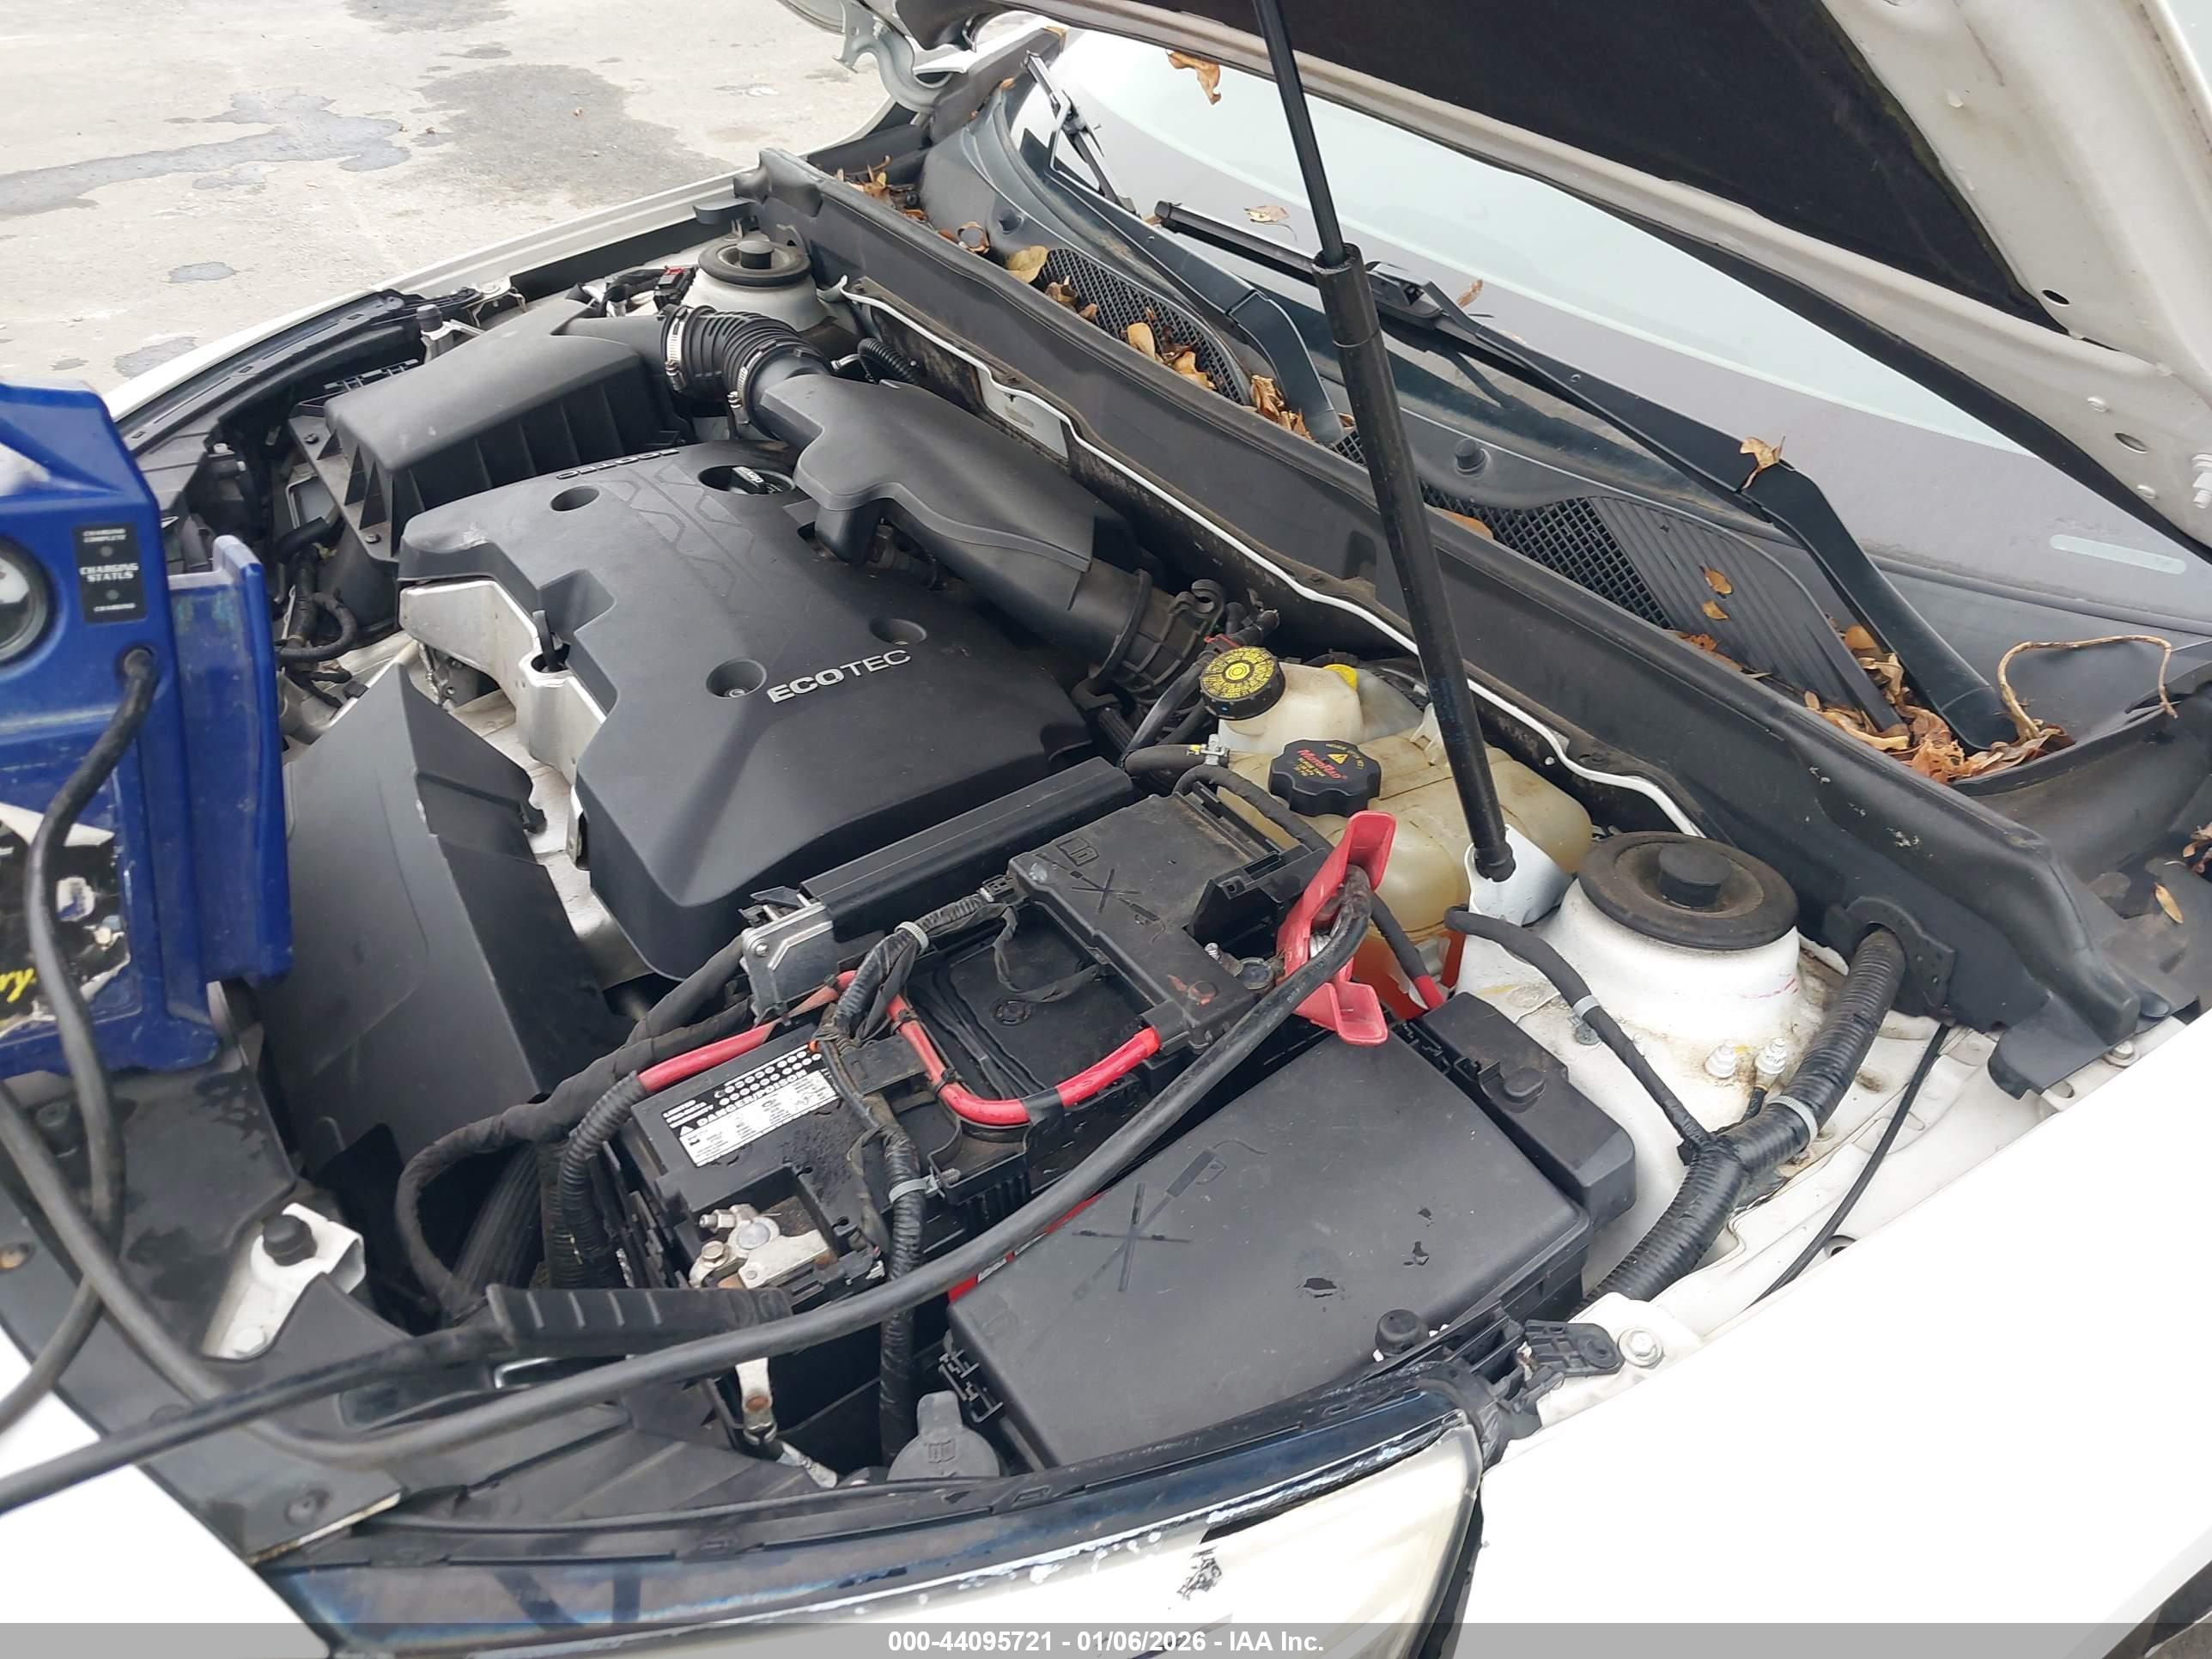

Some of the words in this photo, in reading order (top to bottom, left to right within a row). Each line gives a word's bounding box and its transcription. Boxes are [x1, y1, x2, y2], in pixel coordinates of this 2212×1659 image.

[79, 562, 139, 575] CHARGING
[87, 571, 134, 582] STATUS
[767, 649, 912, 703] ECOTEC
[696, 1069, 808, 1127] DANGER/POISON
